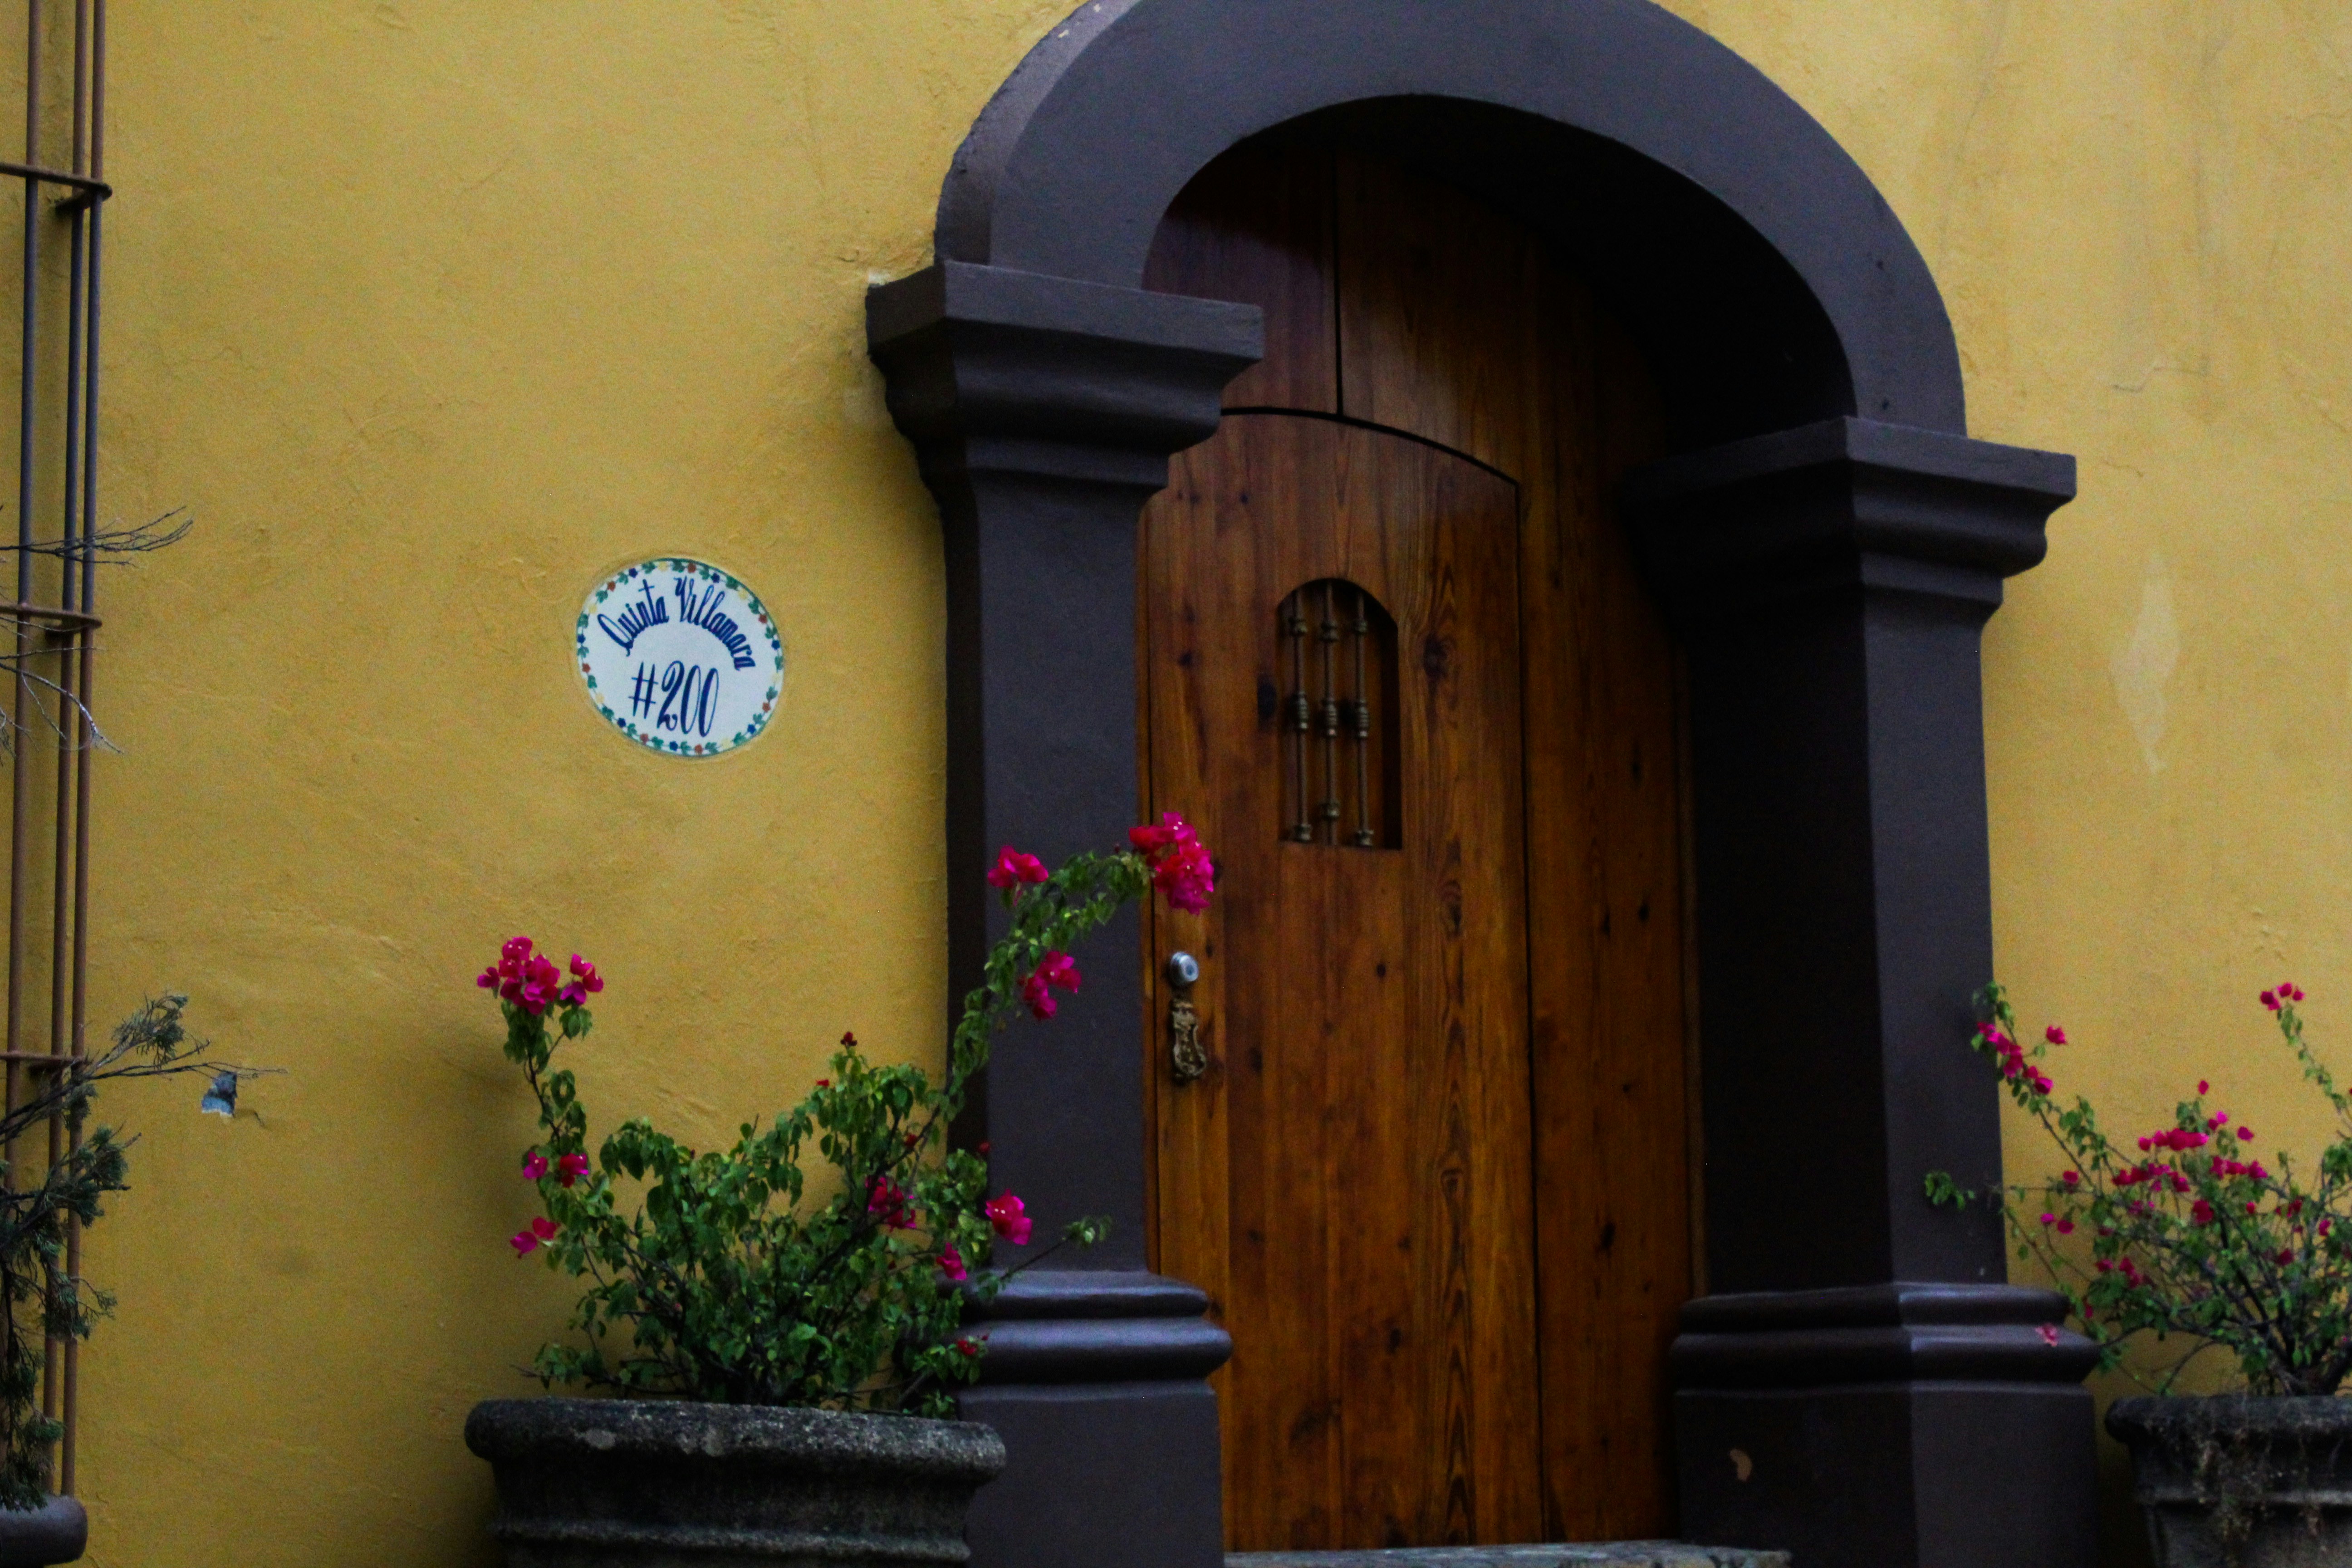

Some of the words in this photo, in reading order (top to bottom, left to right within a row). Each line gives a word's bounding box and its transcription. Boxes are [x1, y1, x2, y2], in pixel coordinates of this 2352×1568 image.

[597, 578, 670, 657] Quinta
[673, 575, 756, 671] Villamara
[628, 660, 719, 737] #200
